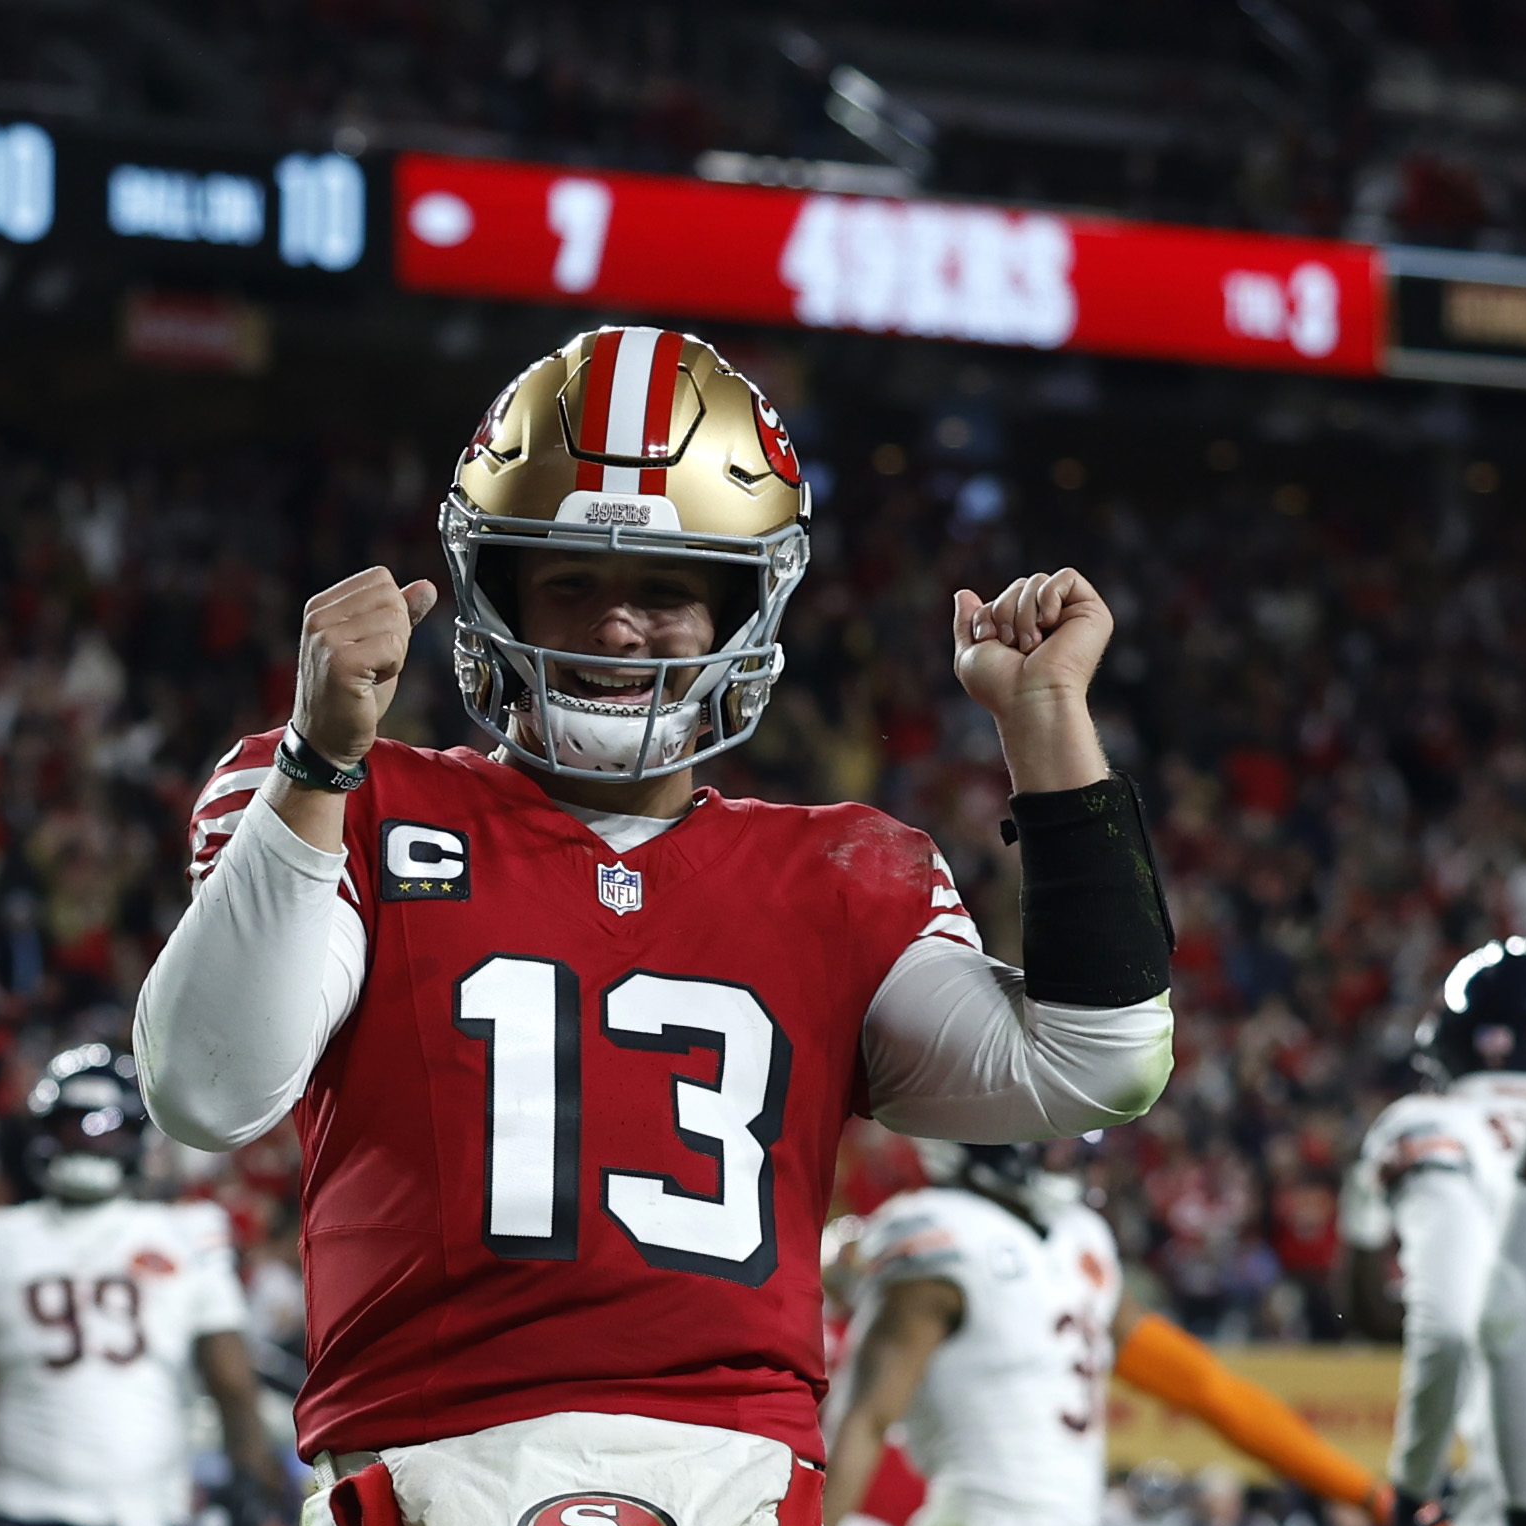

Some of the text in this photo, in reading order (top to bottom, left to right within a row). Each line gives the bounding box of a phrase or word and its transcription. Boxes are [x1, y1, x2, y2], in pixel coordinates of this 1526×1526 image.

[276, 152, 365, 272] 10
[547, 178, 613, 294] 7
[585, 501, 652, 527] 49ERS
[280, 763, 309, 780] FIRM
[386, 824, 464, 880] C
[604, 883, 635, 905] NFL
[452, 950, 793, 1289] 13
